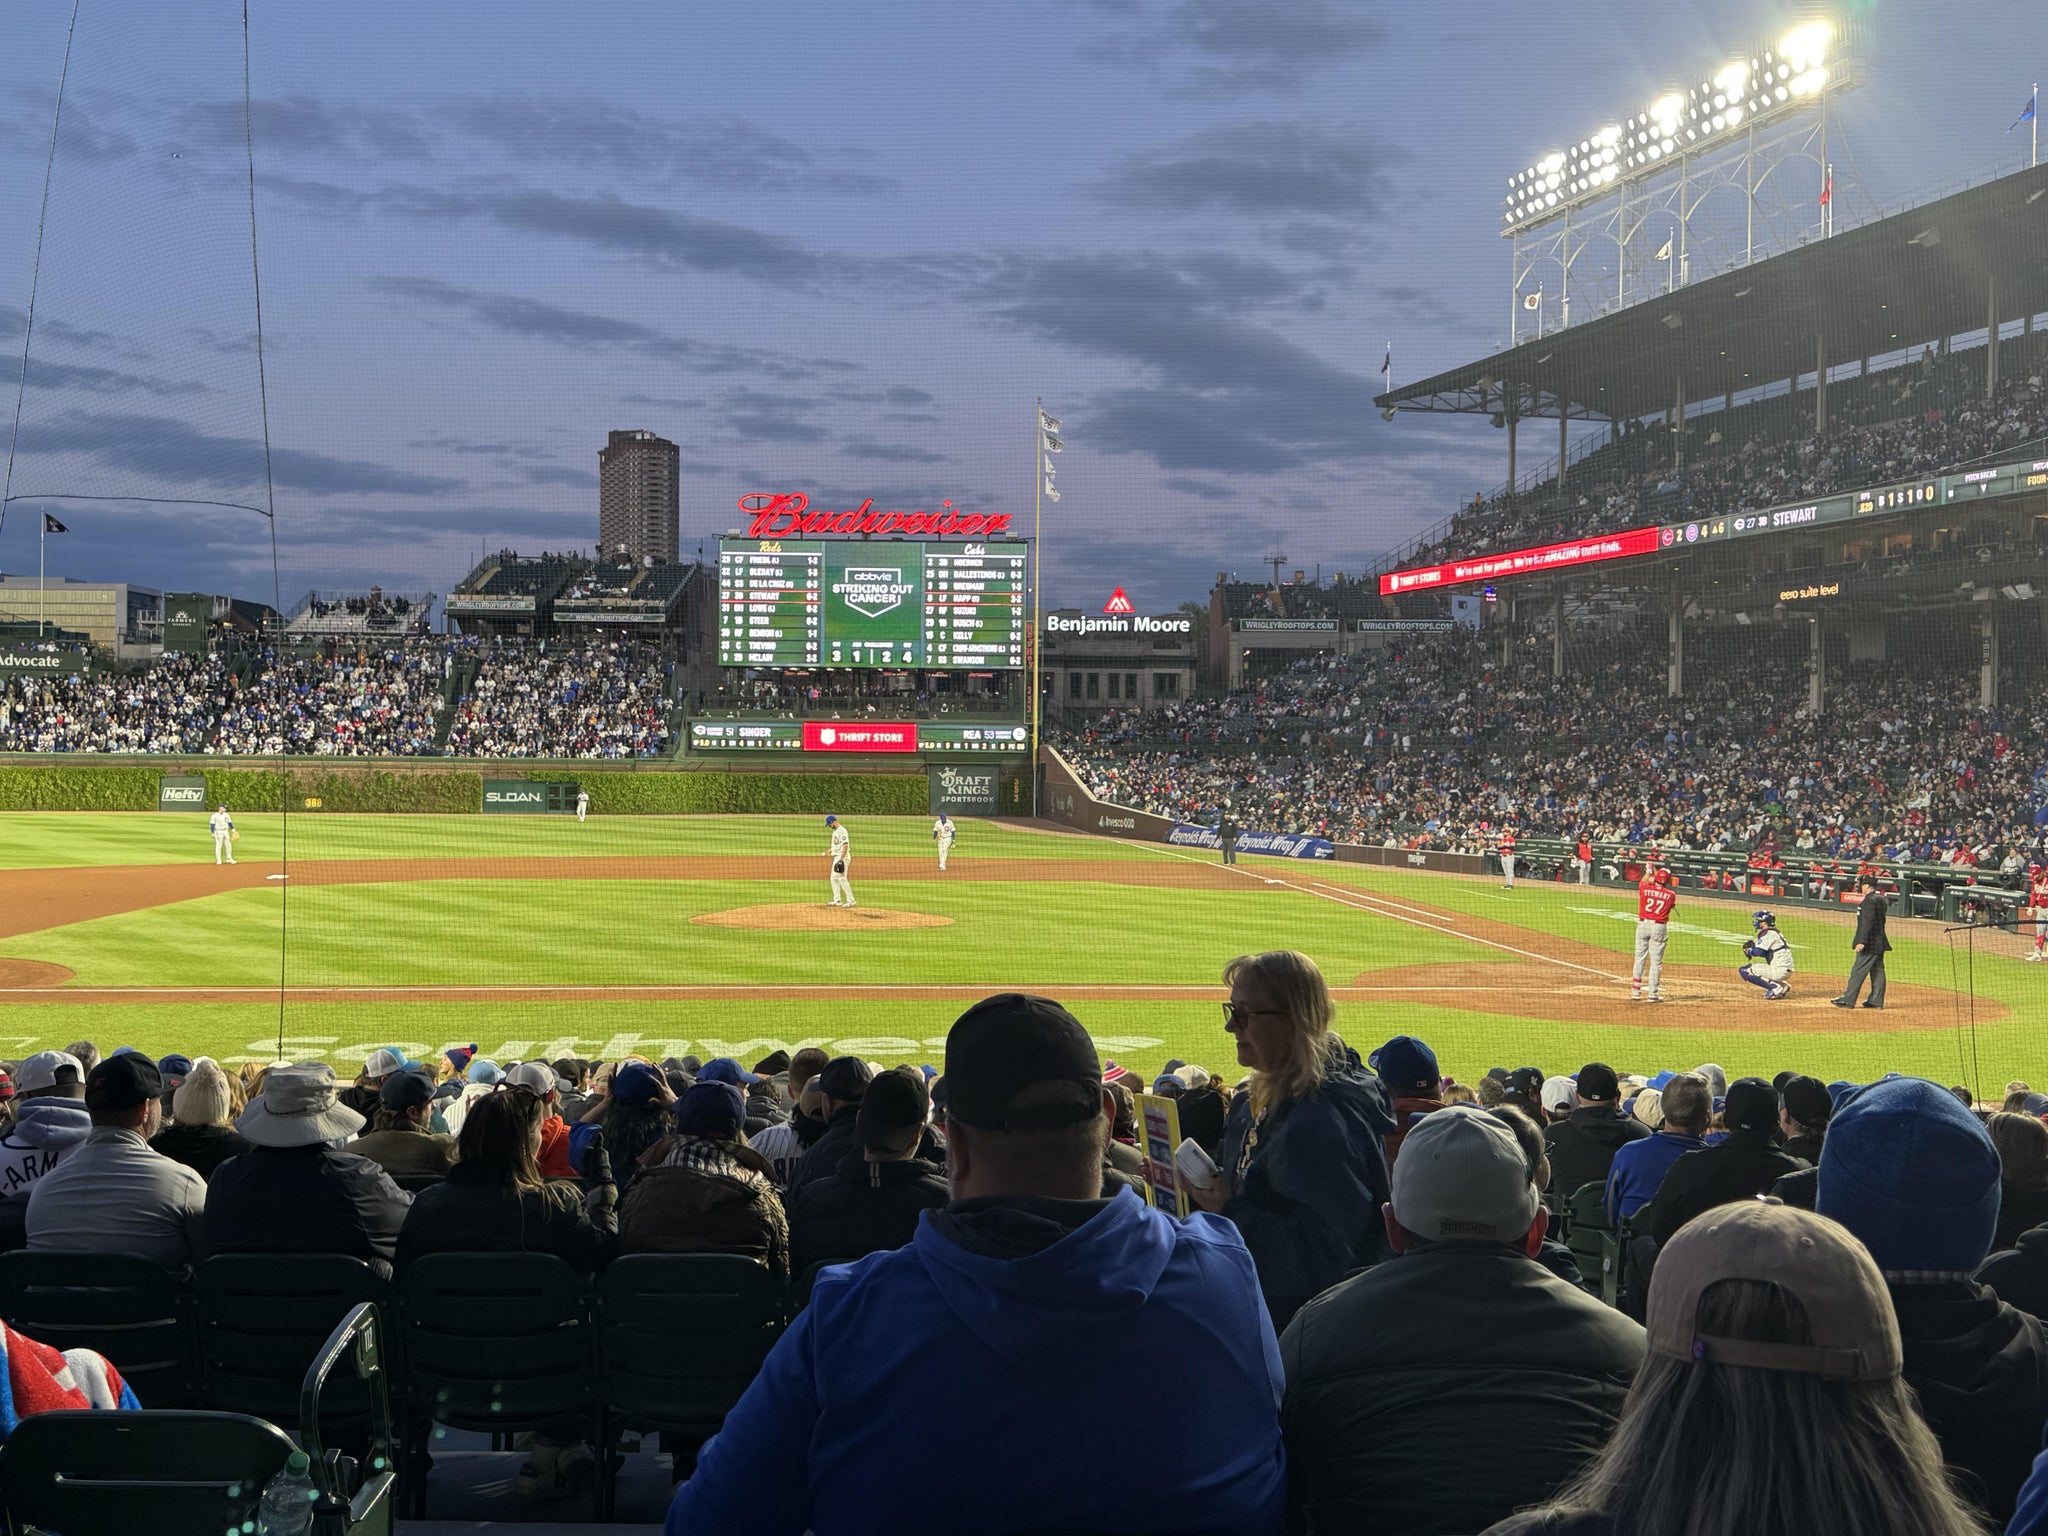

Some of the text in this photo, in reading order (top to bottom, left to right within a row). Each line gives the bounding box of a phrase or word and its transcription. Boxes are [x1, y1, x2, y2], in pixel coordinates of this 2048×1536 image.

[1888, 492, 1894, 507] 1
[1897, 492, 1904, 503] S
[1906, 489, 1913, 504] 1
[738, 491, 1013, 538] Budweiser
[1746, 518, 1756, 529] 27
[1773, 506, 1818, 526] STEWART
[1675, 529, 1683, 542] 2
[1700, 524, 1708, 538] 4
[759, 541, 782, 552] Reds
[963, 543, 986, 555] Cubs
[1545, 549, 1580, 564] AMAZING
[854, 572, 892, 581] abbvie
[721, 579, 731, 587] 44
[759, 580, 767, 588] LA
[832, 583, 914, 594] STRIKING OUT
[1780, 582, 1839, 600] eero suite level
[849, 593, 896, 603] CANCER
[723, 616, 729, 624] 7
[1047, 616, 1191, 635] Benjamin Moore
[735, 641, 741, 649] C
[926, 644, 932, 652] 4
[0, 653, 60, 668] Advocate
[832, 650, 912, 663] 3 1 2 4
[926, 656, 932, 664] 7
[838, 732, 904, 743] THRIFT STORE
[963, 730, 981, 739] REA
[941, 775, 992, 787] DRAFT
[165, 788, 201, 800] Hefty
[947, 785, 990, 795] KINGS
[1105, 815, 1135, 829] Invesco QQQ
[1169, 828, 1219, 848] Reynolds Wrap
[1235, 833, 1273, 851] Reynolds
[1269, 836, 1295, 855] Wrap
[1643, 889, 1671, 900] STEWART
[1644, 897, 1665, 915] 27
